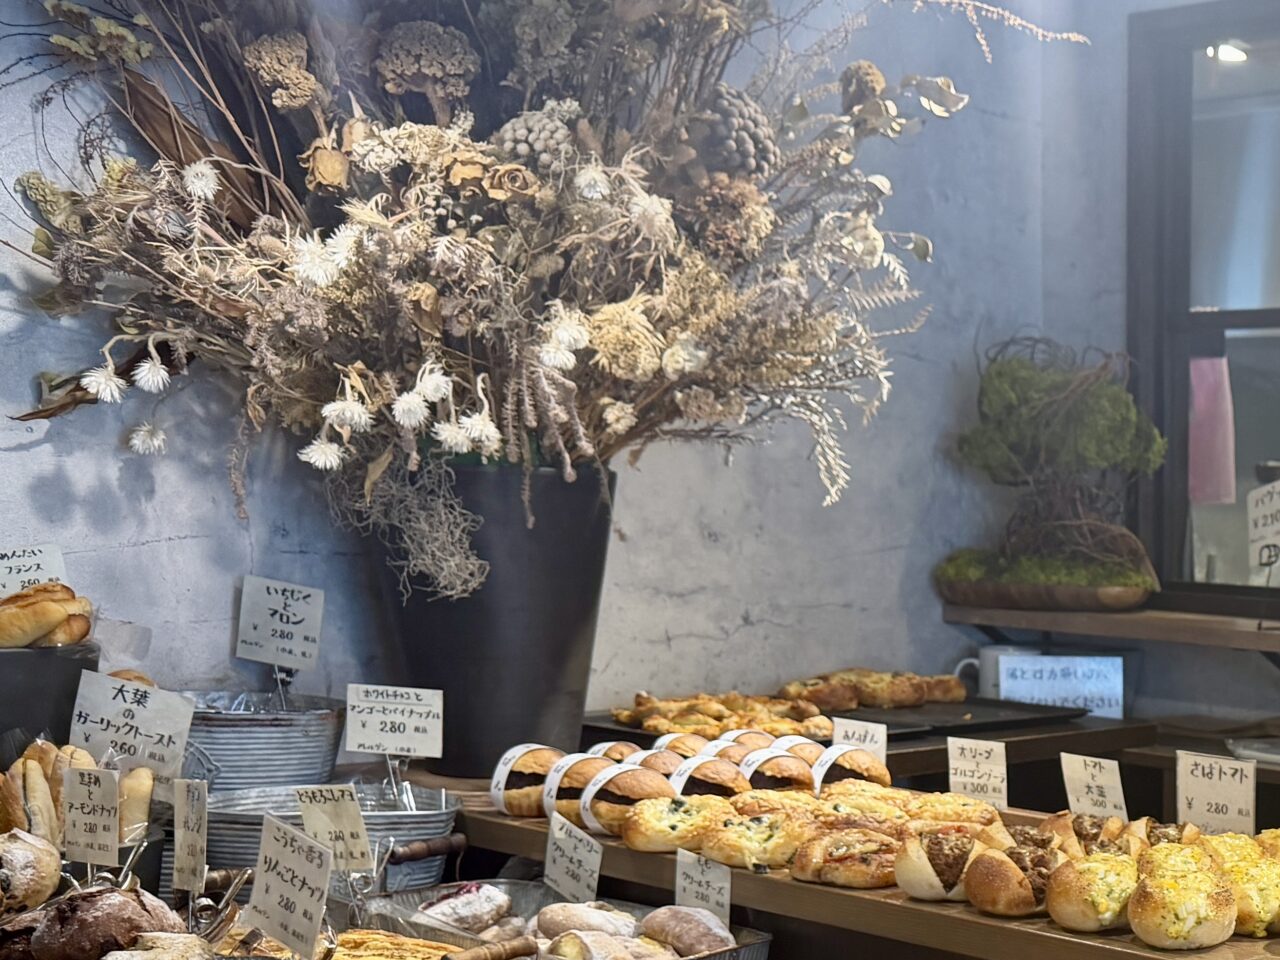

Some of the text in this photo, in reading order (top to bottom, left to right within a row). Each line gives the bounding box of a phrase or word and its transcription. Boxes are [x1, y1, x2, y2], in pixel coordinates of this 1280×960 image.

[5, 564, 44, 575] フランス
[266, 586, 312, 606] いちじく
[282, 602, 291, 613] と
[268, 608, 305, 625] マロン
[271, 628, 293, 640] 280
[112, 684, 150, 708] 大葉
[123, 709, 135, 720] の
[76, 711, 176, 748] ガーリックトースト
[380, 721, 406, 734] 280
[110, 740, 136, 756] 260
[957, 744, 993, 759] オリーブ
[1083, 758, 1105, 773] トマト
[1190, 761, 1248, 784] さばトマト
[952, 766, 1005, 783] ゴルゴンゾーラ
[1185, 796, 1194, 810] ¥
[1206, 802, 1228, 815] 280
[264, 855, 325, 903] りんごとナッツ
[277, 894, 296, 914] 280
